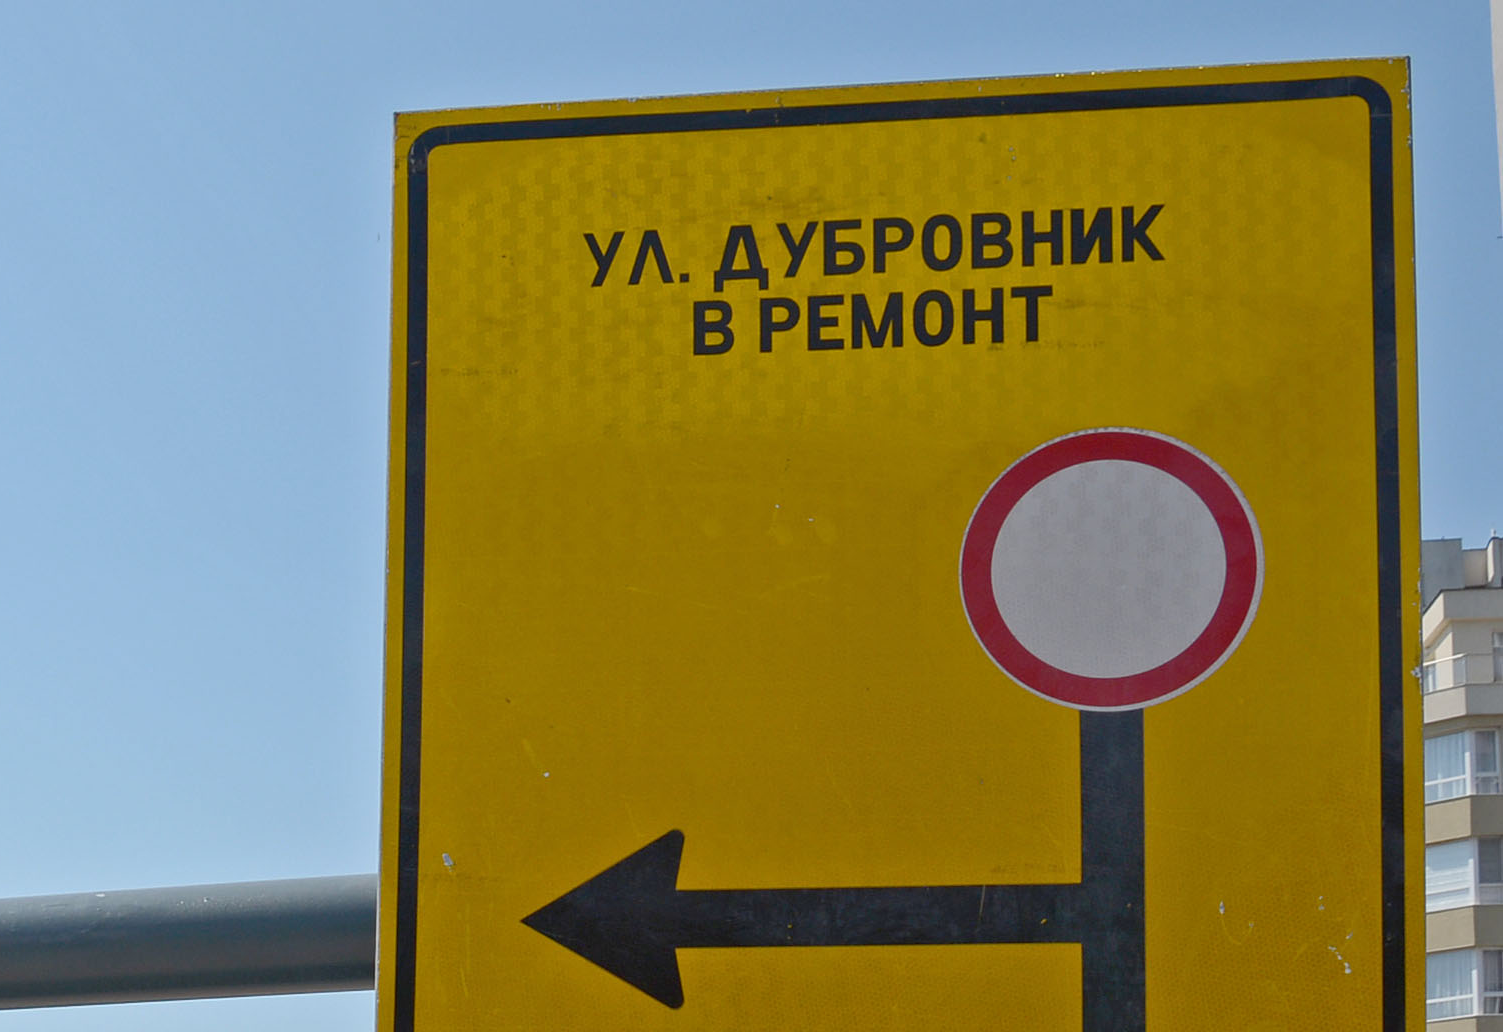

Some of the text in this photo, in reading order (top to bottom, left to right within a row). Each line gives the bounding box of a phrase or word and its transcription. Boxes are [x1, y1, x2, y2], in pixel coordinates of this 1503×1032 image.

[583, 204, 1165, 293] УЛ. ДУБРОВНИК
[693, 285, 1053, 356] В РЕМОНТ
